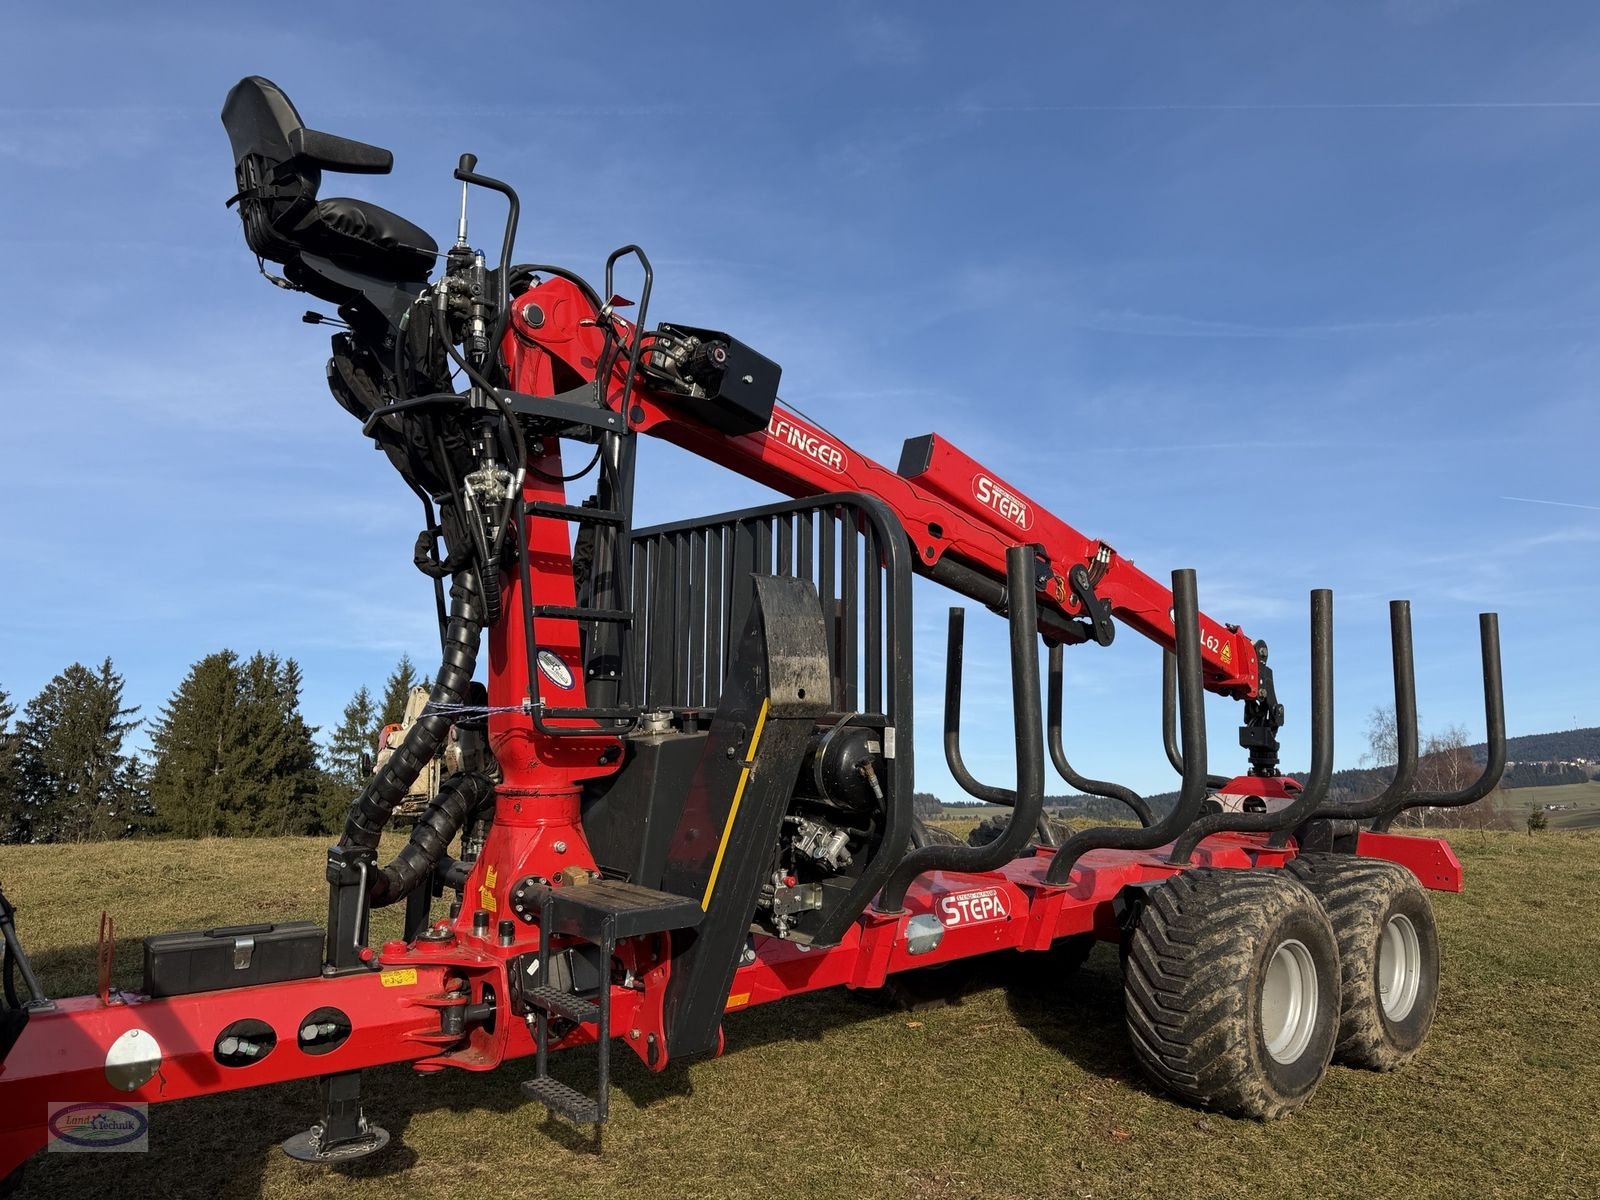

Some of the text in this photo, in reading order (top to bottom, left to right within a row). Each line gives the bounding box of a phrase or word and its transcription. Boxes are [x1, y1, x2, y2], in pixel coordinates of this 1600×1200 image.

[764, 415, 842, 470] LFINGER
[976, 477, 1026, 528] STEPA
[941, 895, 1006, 925] STEPA
